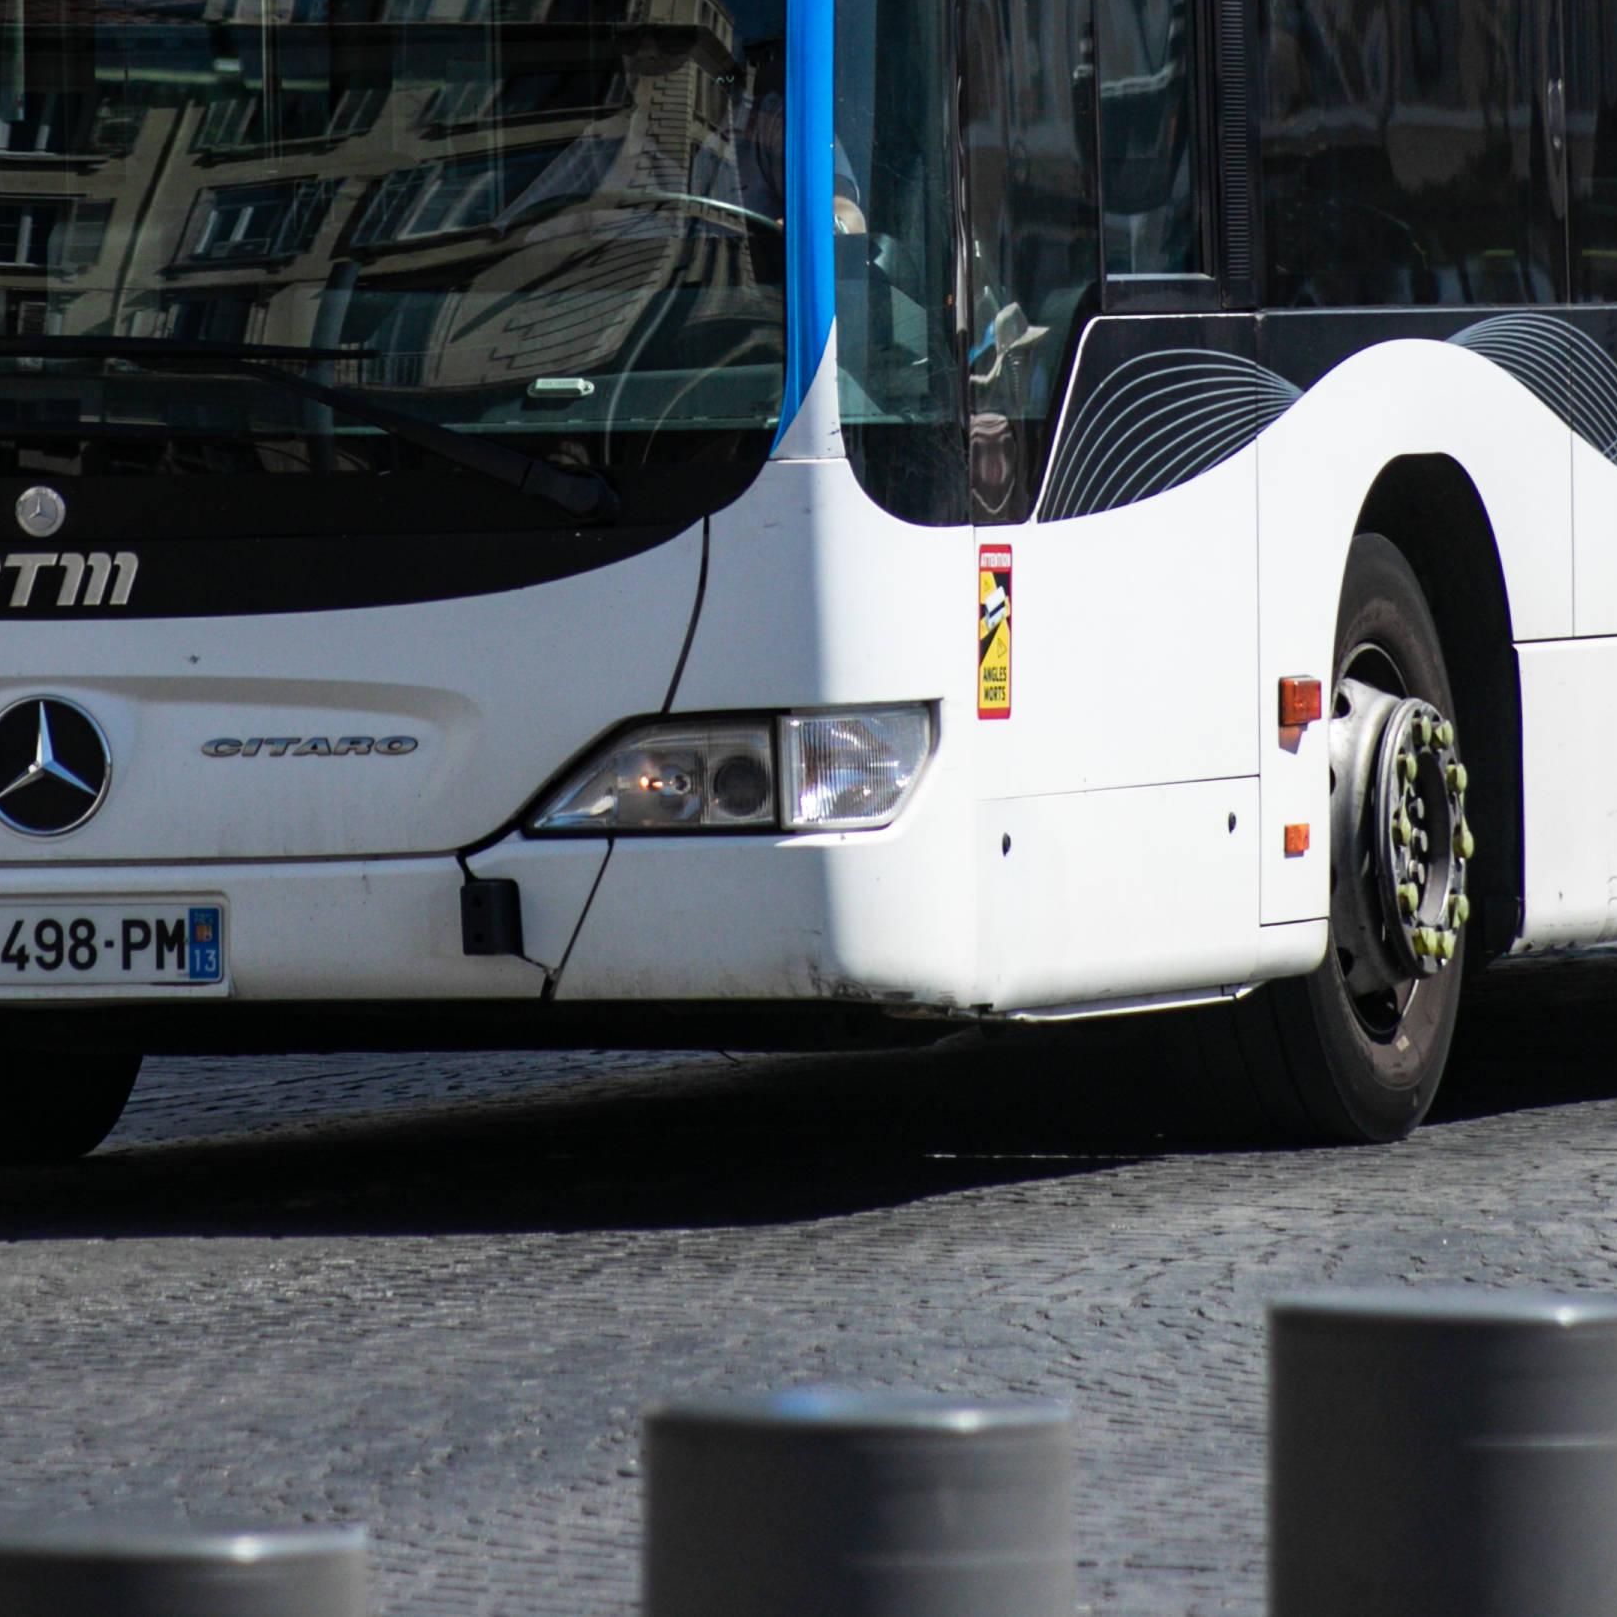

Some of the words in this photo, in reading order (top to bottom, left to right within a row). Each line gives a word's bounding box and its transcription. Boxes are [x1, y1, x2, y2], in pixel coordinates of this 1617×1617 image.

[983, 666, 1007, 682] ANGLES
[984, 686, 1006, 701] MORTS
[201, 736, 418, 758] CITARO
[193, 948, 217, 973] 13
